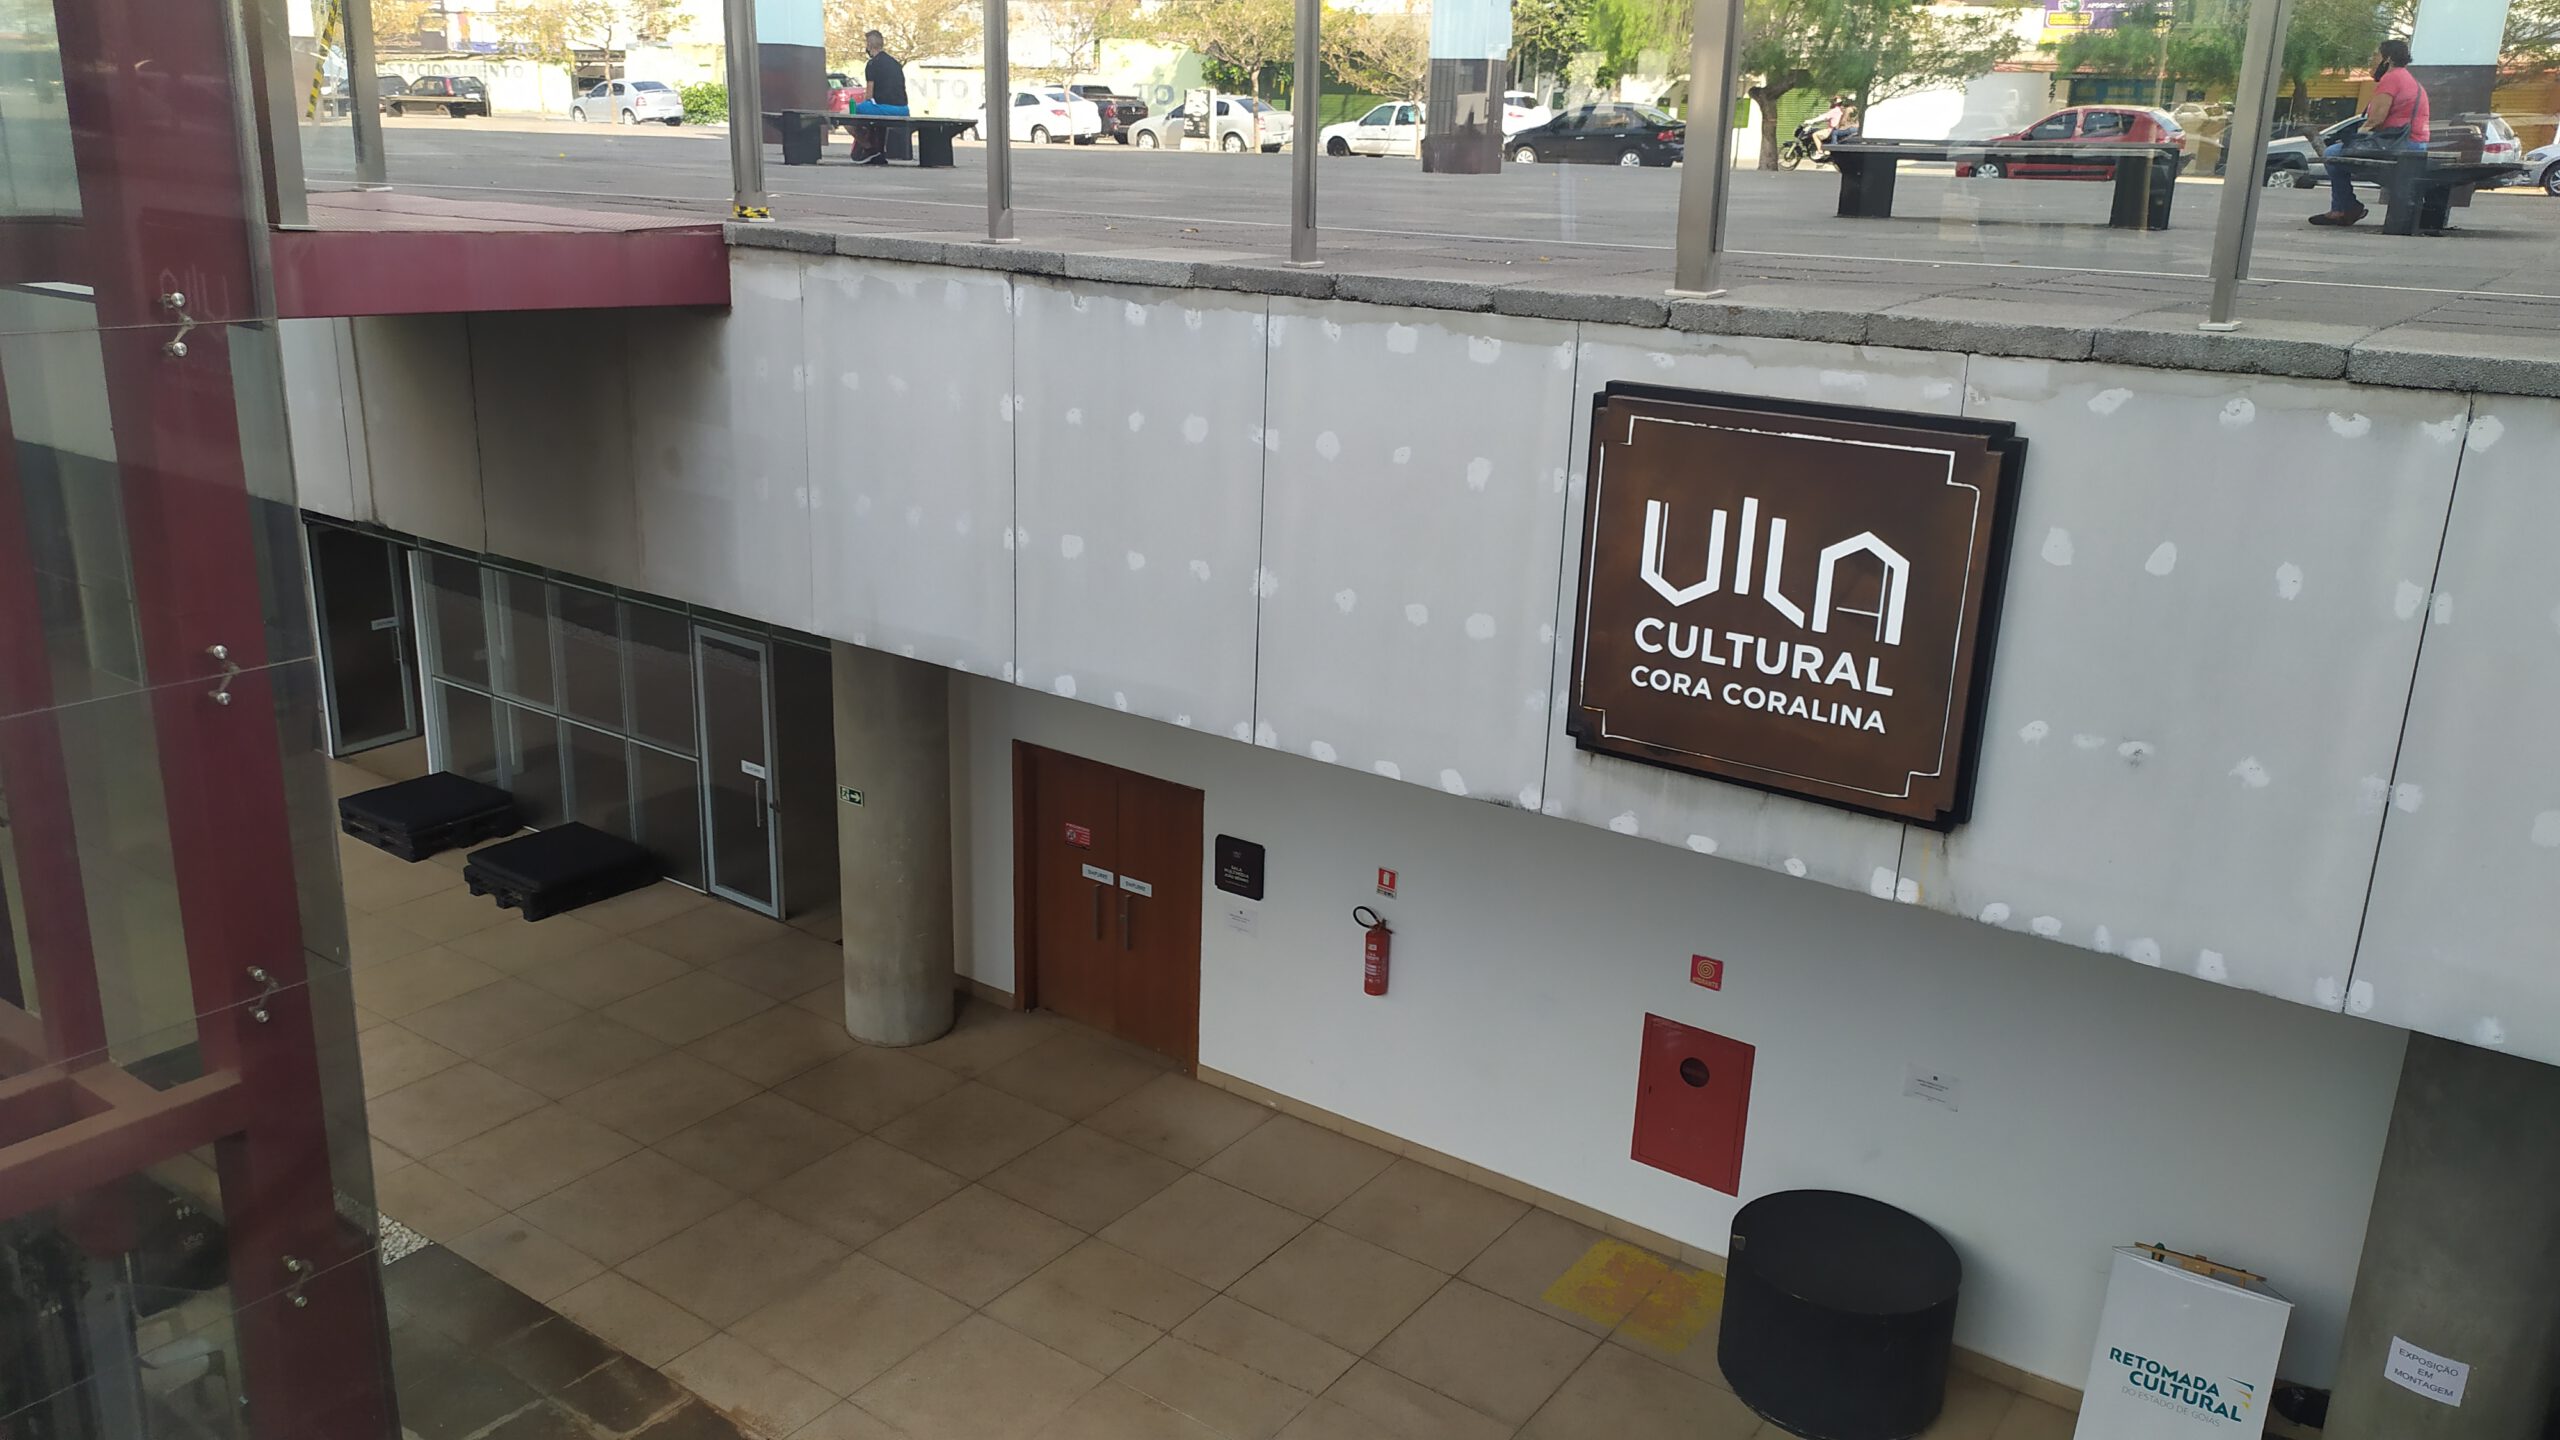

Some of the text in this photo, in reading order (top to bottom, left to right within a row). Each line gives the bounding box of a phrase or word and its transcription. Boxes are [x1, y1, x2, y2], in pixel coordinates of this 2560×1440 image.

[1633, 617, 1894, 696] CULTURAL
[1630, 665, 1886, 734] CORA CORALINA
[2109, 1347, 2220, 1397] RETOMADA
[2394, 1368, 2455, 1397] MONTAGEM
[2399, 1348, 2459, 1377] EXPOSIÇÃO
[2417, 1368, 2434, 1380] EM
[2121, 1385, 2136, 1397] DO
[2138, 1390, 2174, 1410] ESTADO
[2176, 1404, 2189, 1416] DE
[2129, 1370, 2242, 1422] CULTURAL
